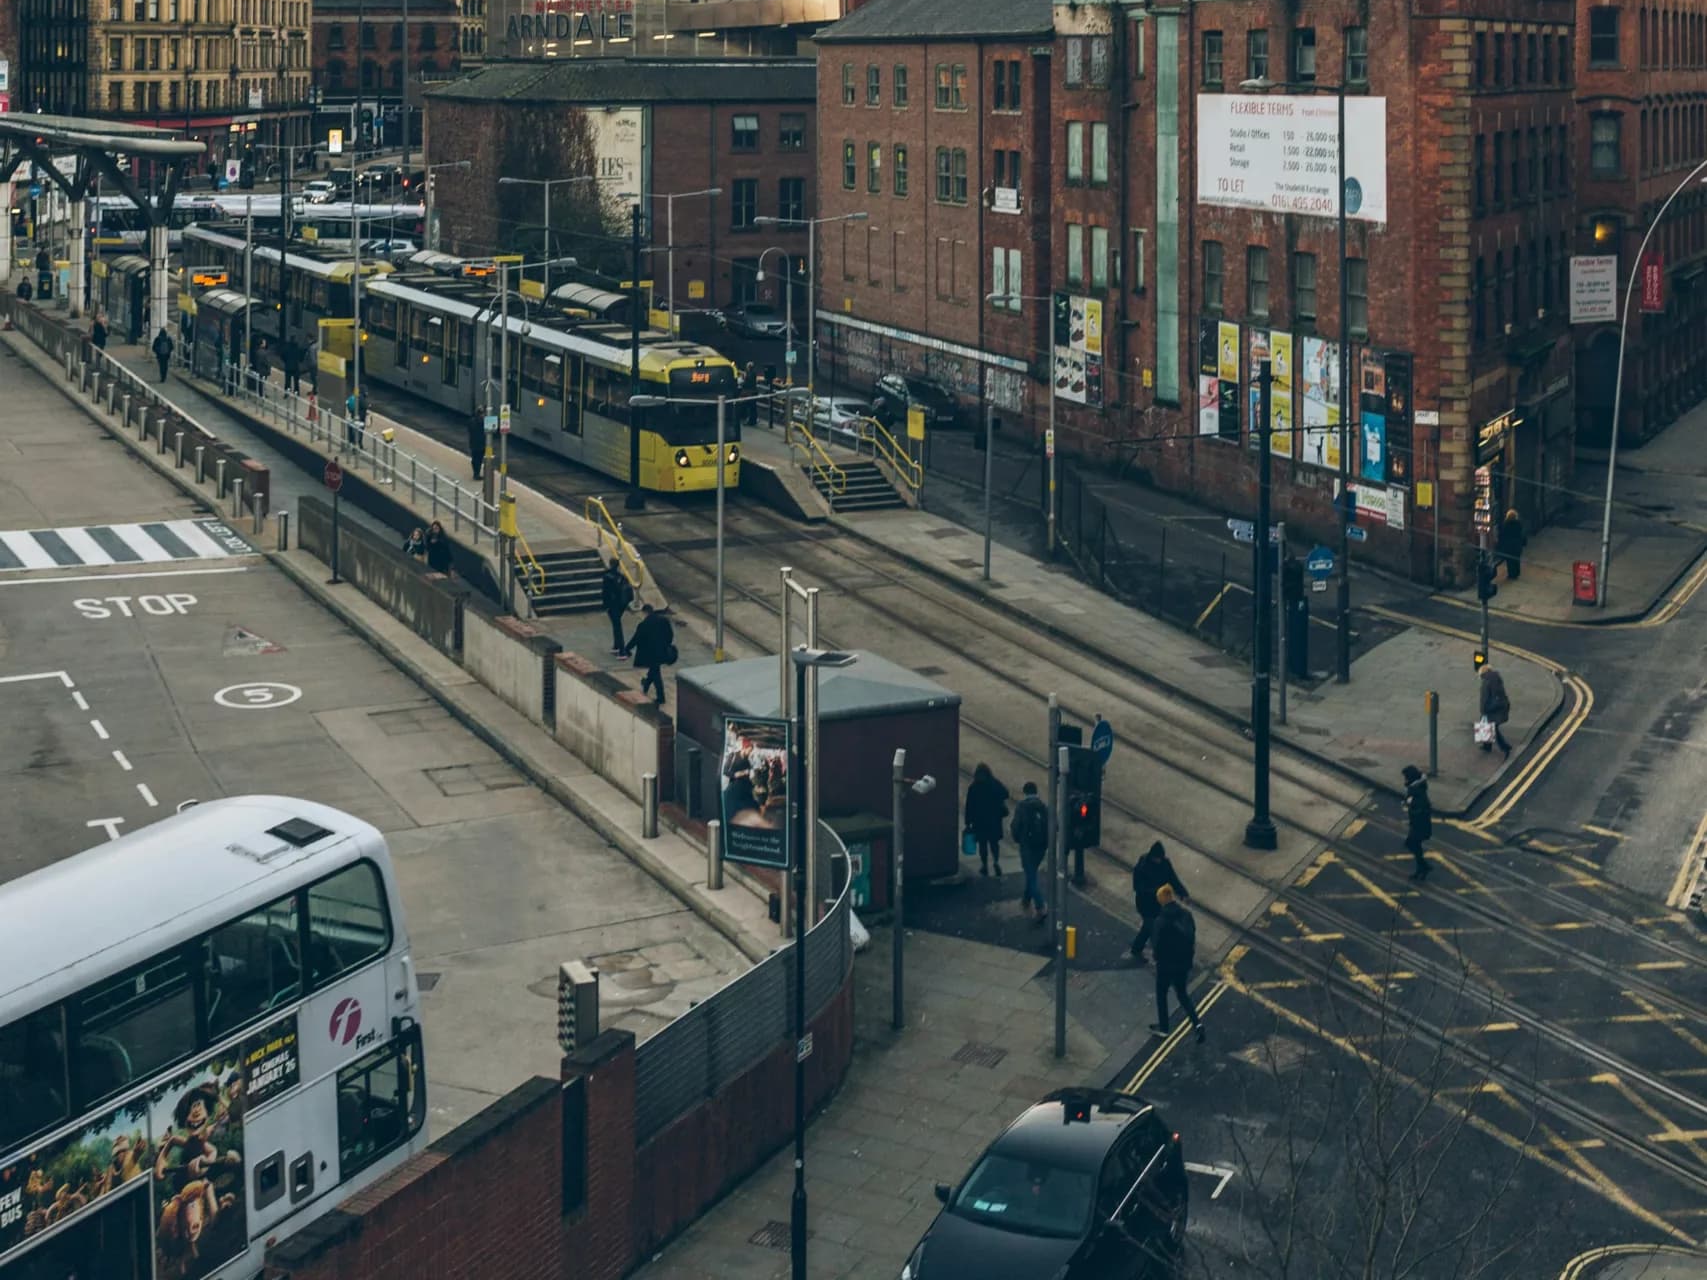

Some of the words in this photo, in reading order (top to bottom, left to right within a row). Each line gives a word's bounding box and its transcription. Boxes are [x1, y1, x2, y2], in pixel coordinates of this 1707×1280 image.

[535, 0, 632, 12] MANCHESTER
[507, 13, 632, 40] ARNDALE
[1230, 101, 1265, 115] FLEXIBLE
[1267, 103, 1294, 117] TERMS
[1229, 127, 1247, 138] Studio
[1251, 128, 1270, 140] Offices
[1229, 142, 1246, 152] Retail
[1217, 177, 1229, 192] TO
[1230, 178, 1245, 193] LET
[73, 593, 198, 619] STOP
[243, 687, 273, 703] 5
[356, 1028, 376, 1050] First
[252, 1065, 261, 1080] IN
[260, 1050, 291, 1072] CINEMAS
[246, 1062, 285, 1096] JANUARY
[285, 1057, 297, 1075] 26
[0, 1186, 22, 1213] FEW
[1, 1203, 23, 1229] BUS
